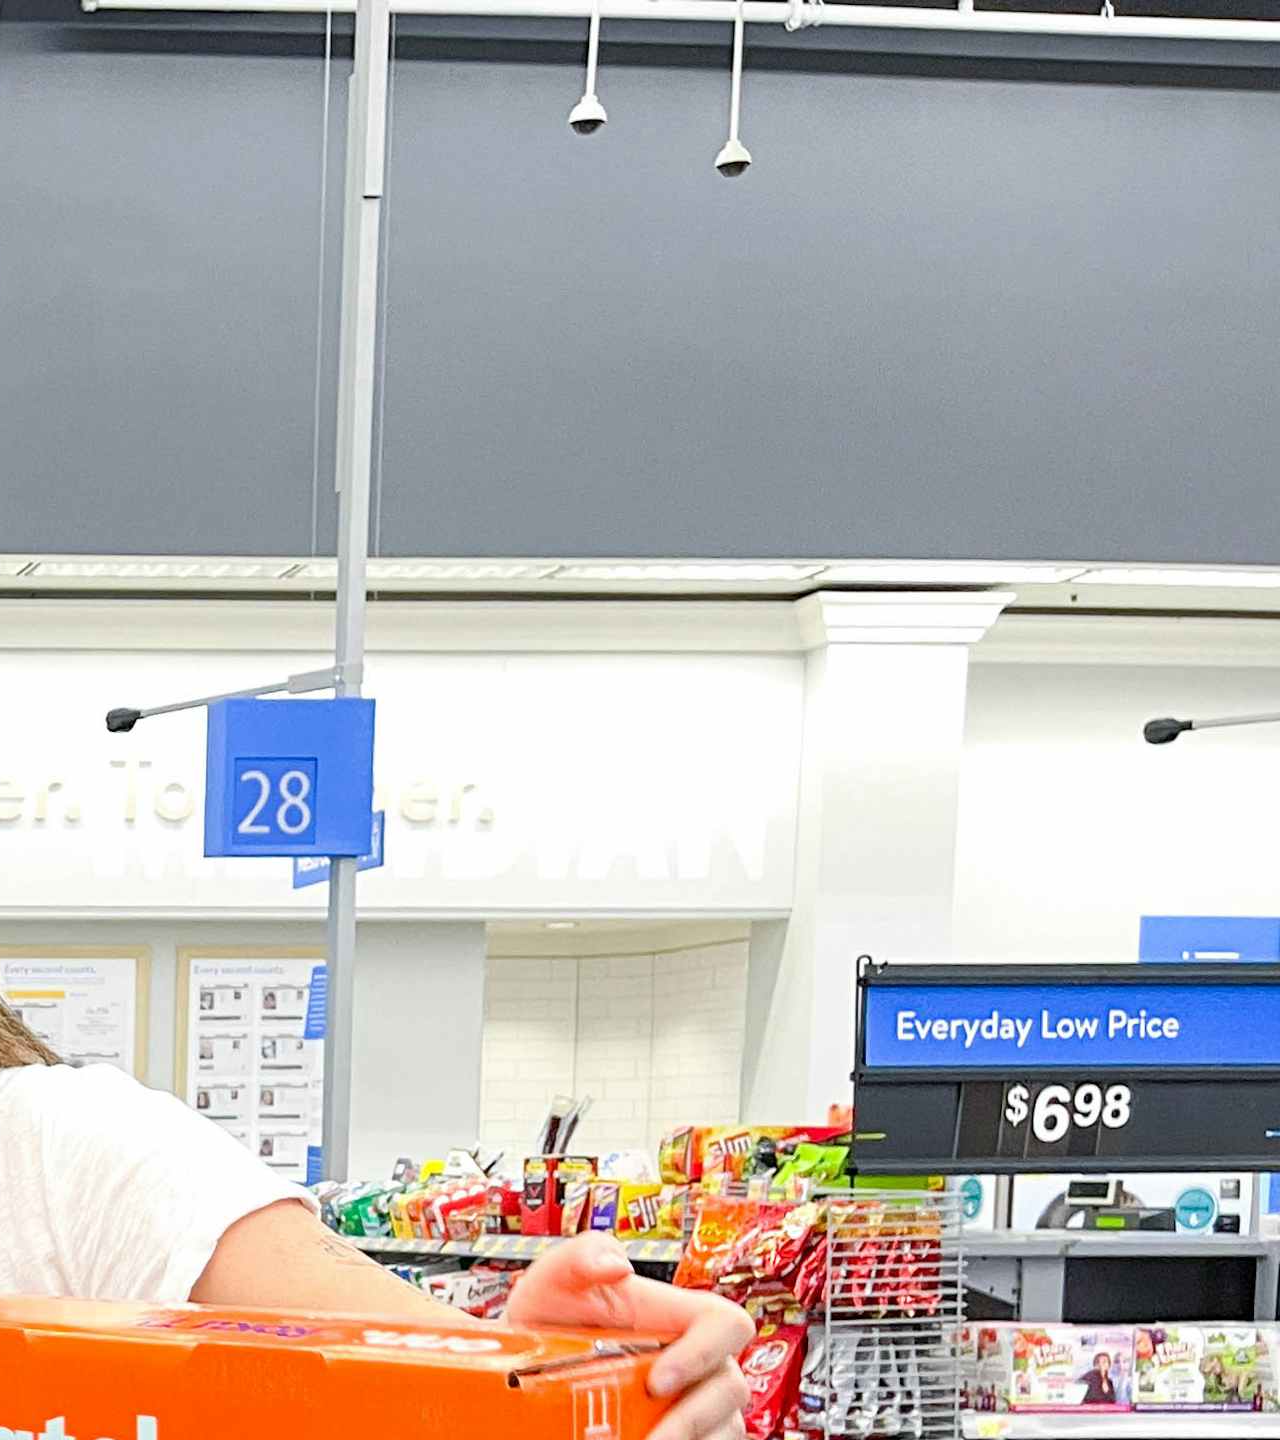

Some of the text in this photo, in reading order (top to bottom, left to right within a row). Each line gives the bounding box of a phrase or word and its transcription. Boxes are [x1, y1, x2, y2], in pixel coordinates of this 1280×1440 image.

[237, 766, 314, 838] 28
[896, 1008, 1180, 1048] Everyday Low Price
